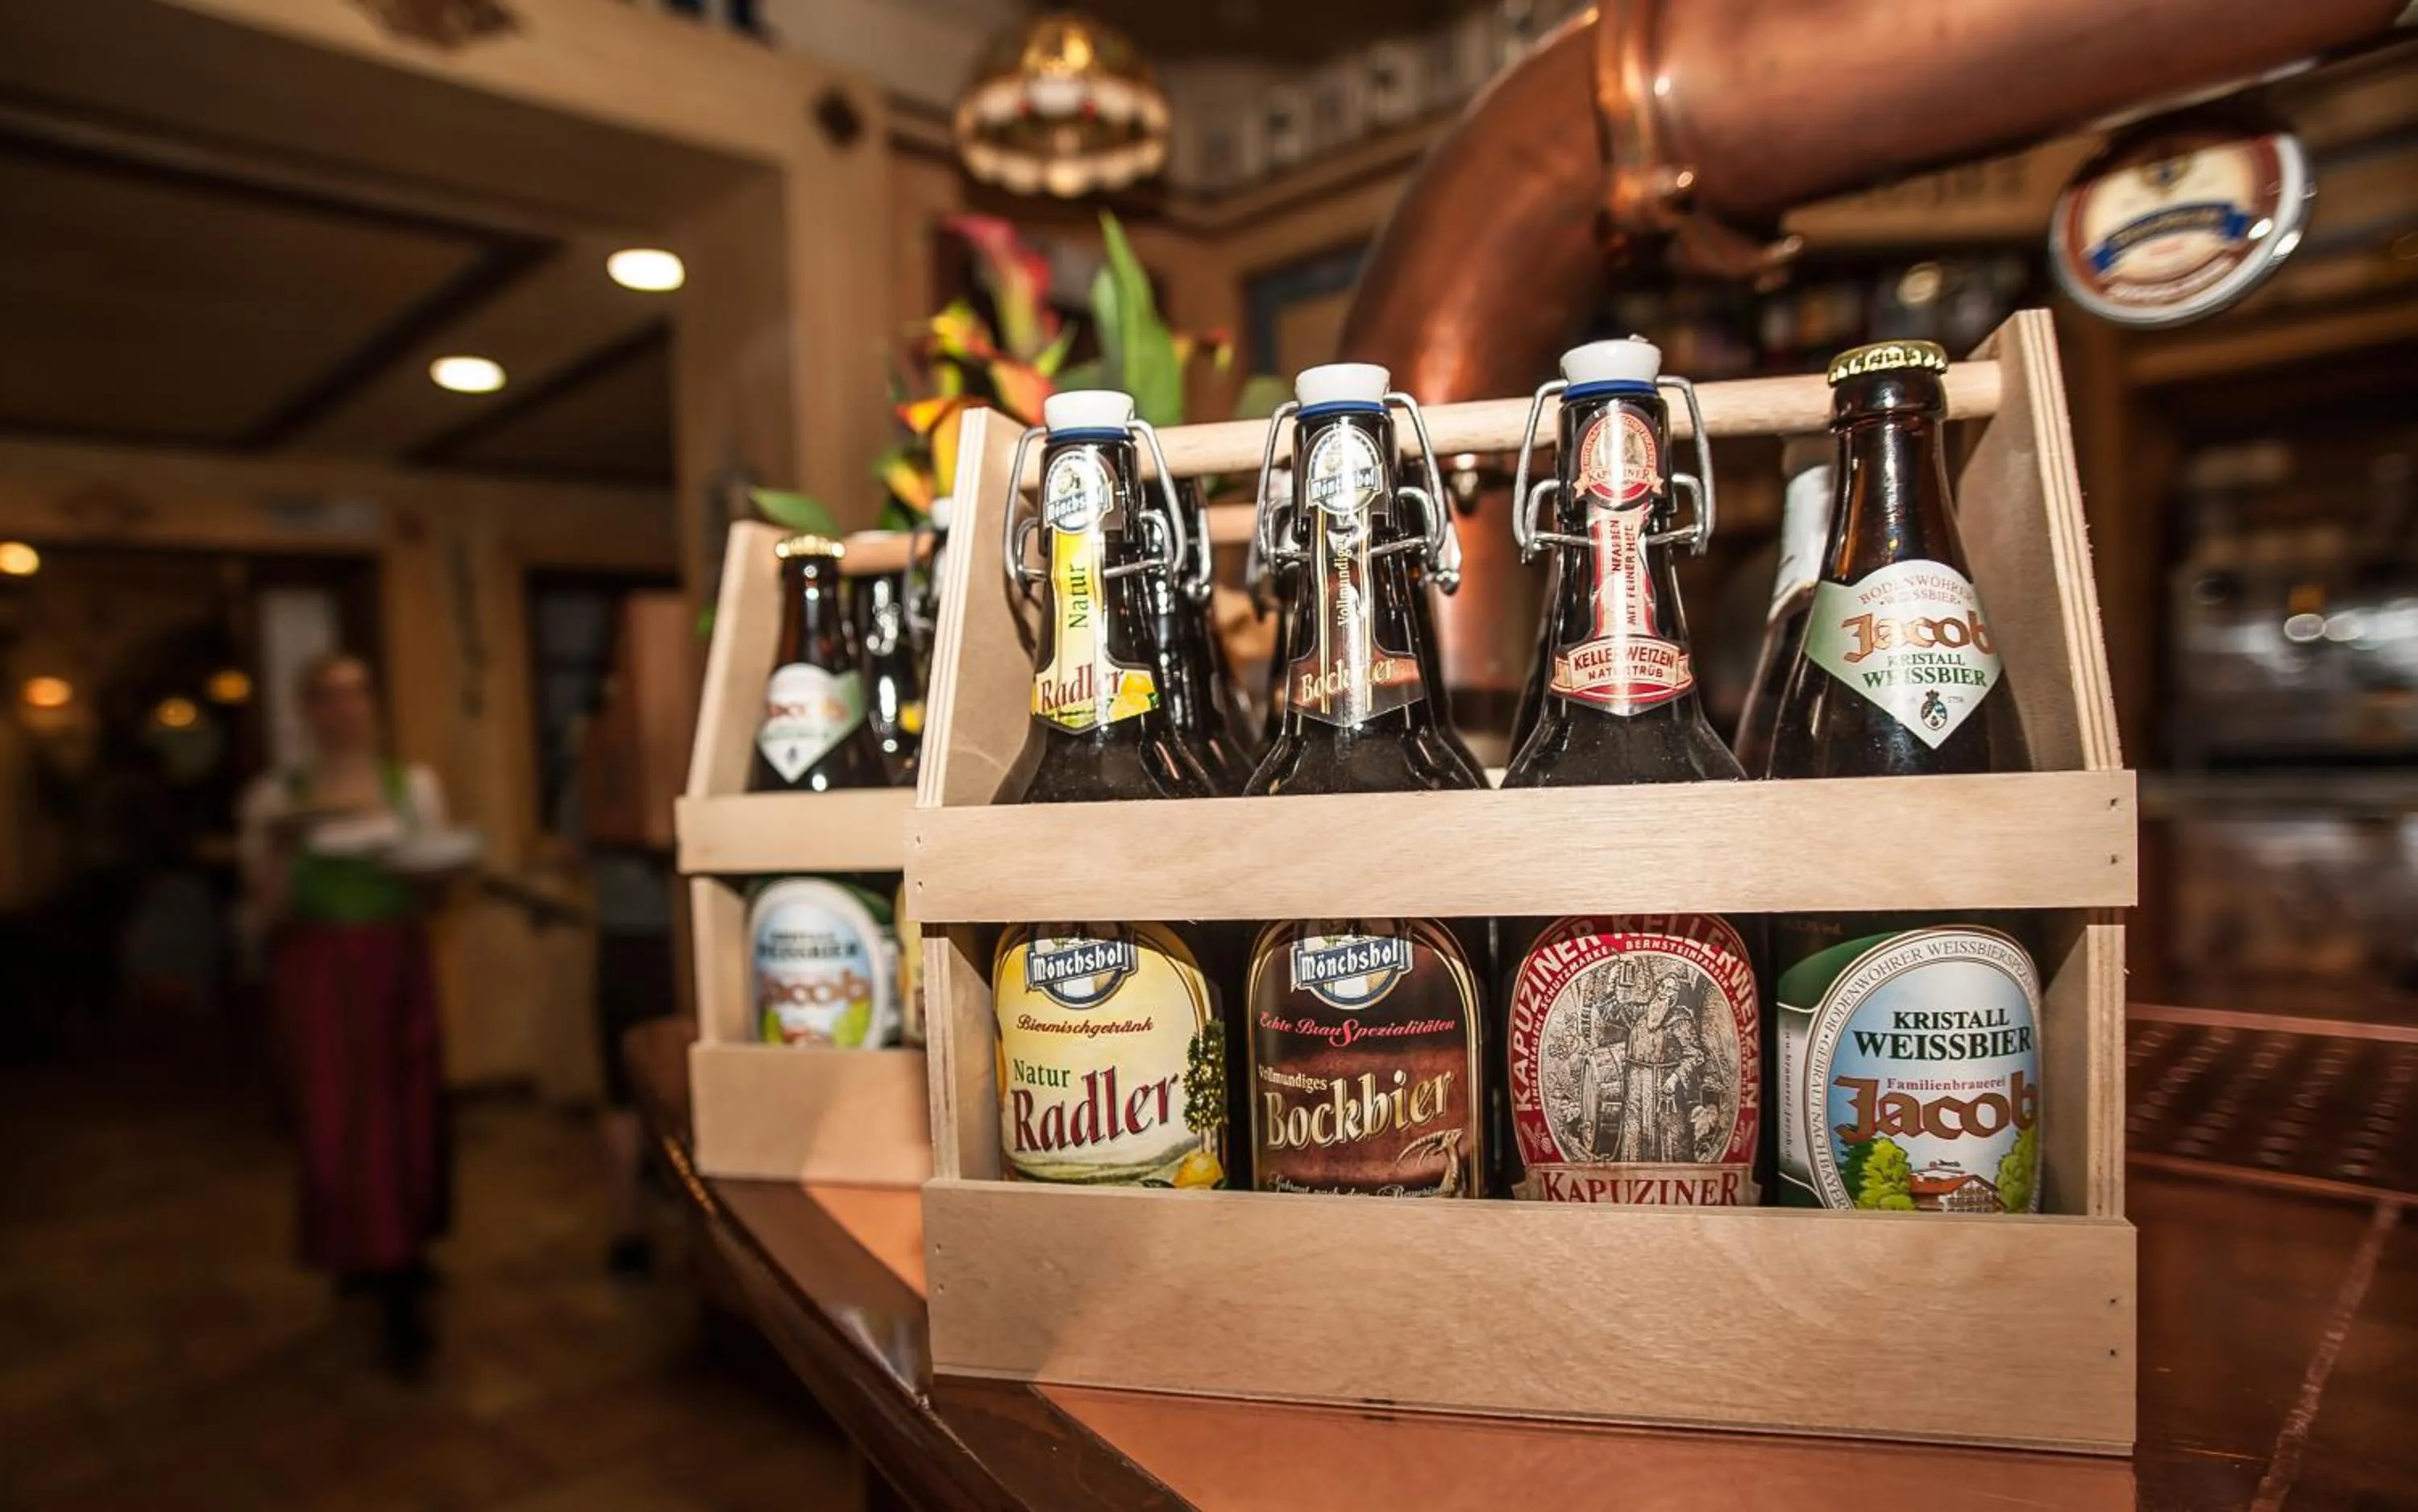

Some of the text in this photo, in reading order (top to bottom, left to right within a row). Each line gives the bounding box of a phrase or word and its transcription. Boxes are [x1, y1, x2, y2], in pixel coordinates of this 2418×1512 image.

[1624, 555, 1636, 599] FEINER
[1069, 565, 1089, 629] Natur
[1624, 603, 1637, 625] MIT
[1842, 610, 1997, 663] Jacob
[1573, 646, 1674, 671] KELLEWEIZEN
[1539, 945, 1610, 1010] SCHUTZMARKE
[1625, 939, 1730, 989] BERNSTEINFARBEN
[1016, 1013, 1154, 1038] Biermischgetränk
[1514, 920, 1602, 1111] KAPUZINER
[1892, 1008, 2011, 1030] KRISTALL
[1853, 1025, 2033, 1060] WEISSBIER
[1013, 1058, 1071, 1088] Natur
[1887, 1074, 2006, 1090] Familienbrauerei
[1011, 1065, 1179, 1153] Radler
[1263, 1070, 1455, 1150] Bockbier
[1832, 1070, 2039, 1146] Jacob
[1541, 1172, 1739, 1206] KAPUZINER
